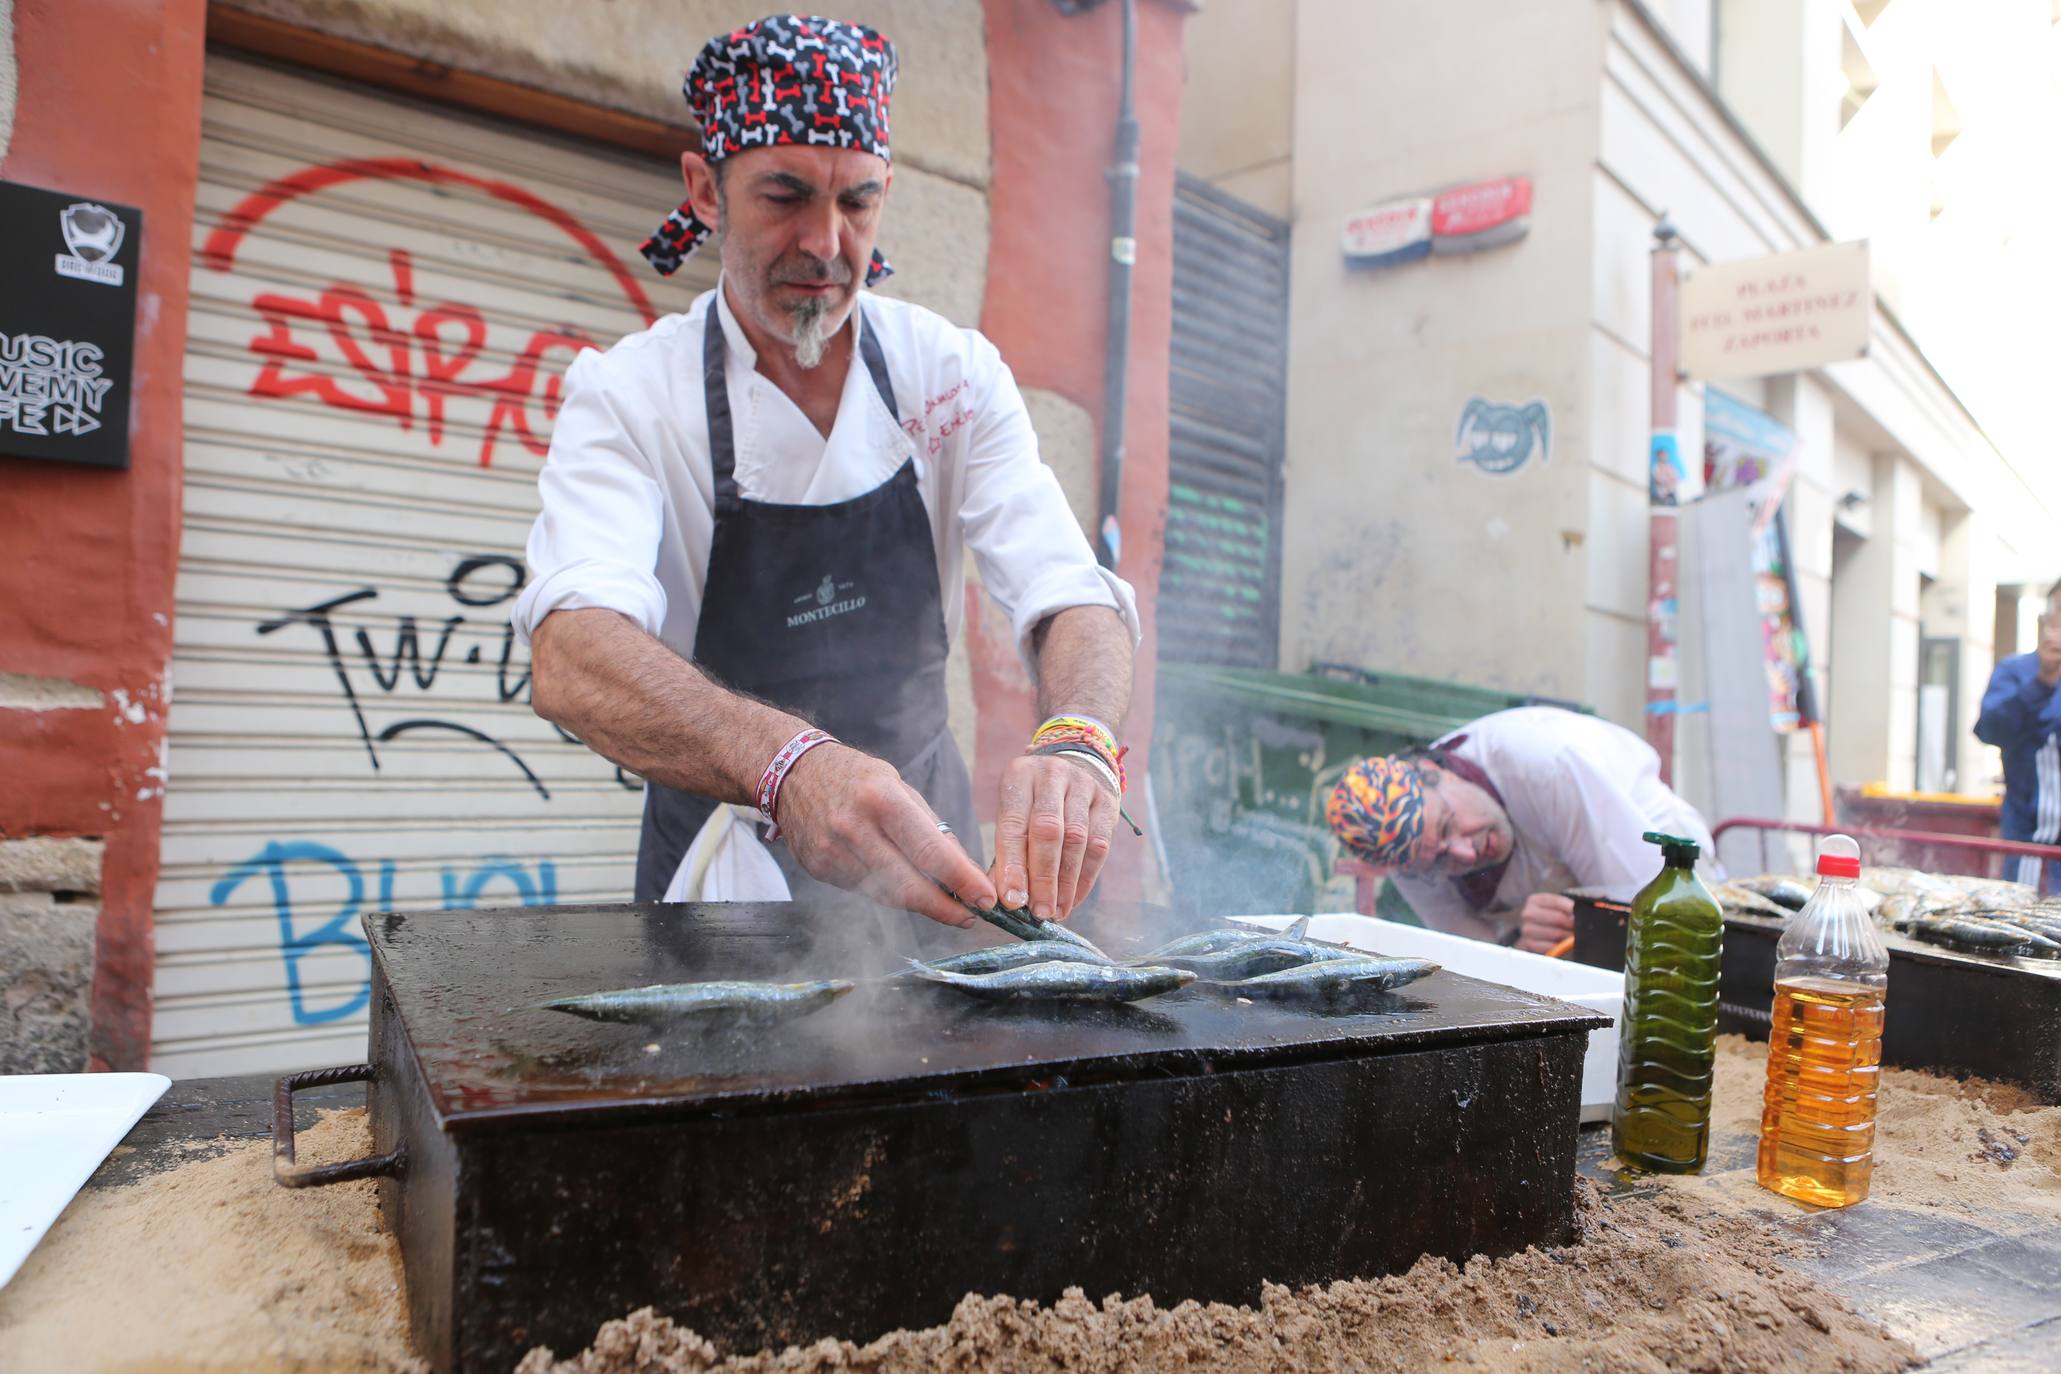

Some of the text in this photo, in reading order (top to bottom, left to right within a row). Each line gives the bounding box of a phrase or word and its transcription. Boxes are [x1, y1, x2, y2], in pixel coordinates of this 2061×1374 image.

[1736, 274, 1807, 299] PLAZA
[0, 332, 104, 379] USIC
[787, 596, 866, 628] MONTECILLO
